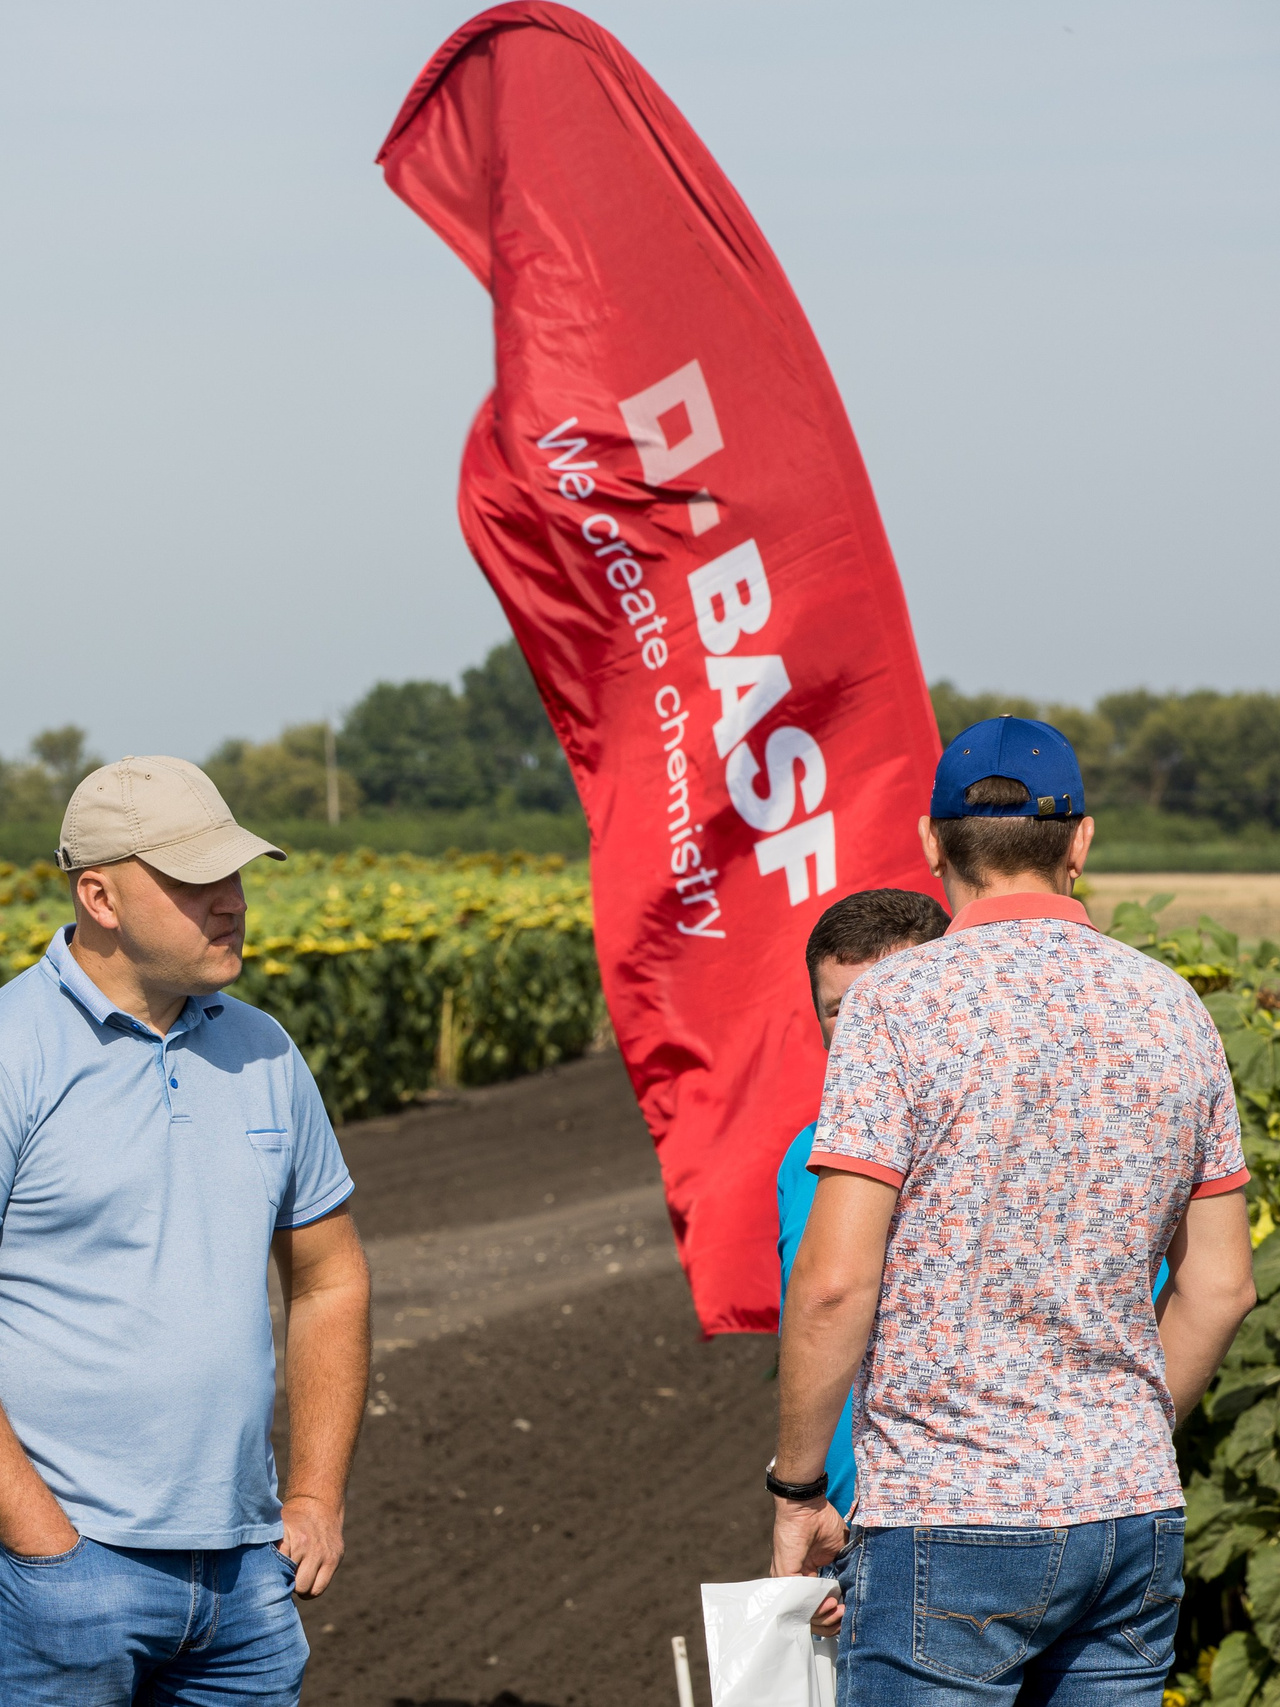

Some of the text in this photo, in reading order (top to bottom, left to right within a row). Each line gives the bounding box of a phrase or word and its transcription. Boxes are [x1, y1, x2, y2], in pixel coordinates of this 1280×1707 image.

[537, 417, 727, 939] We create chemistry
[687, 538, 838, 907] BASF
